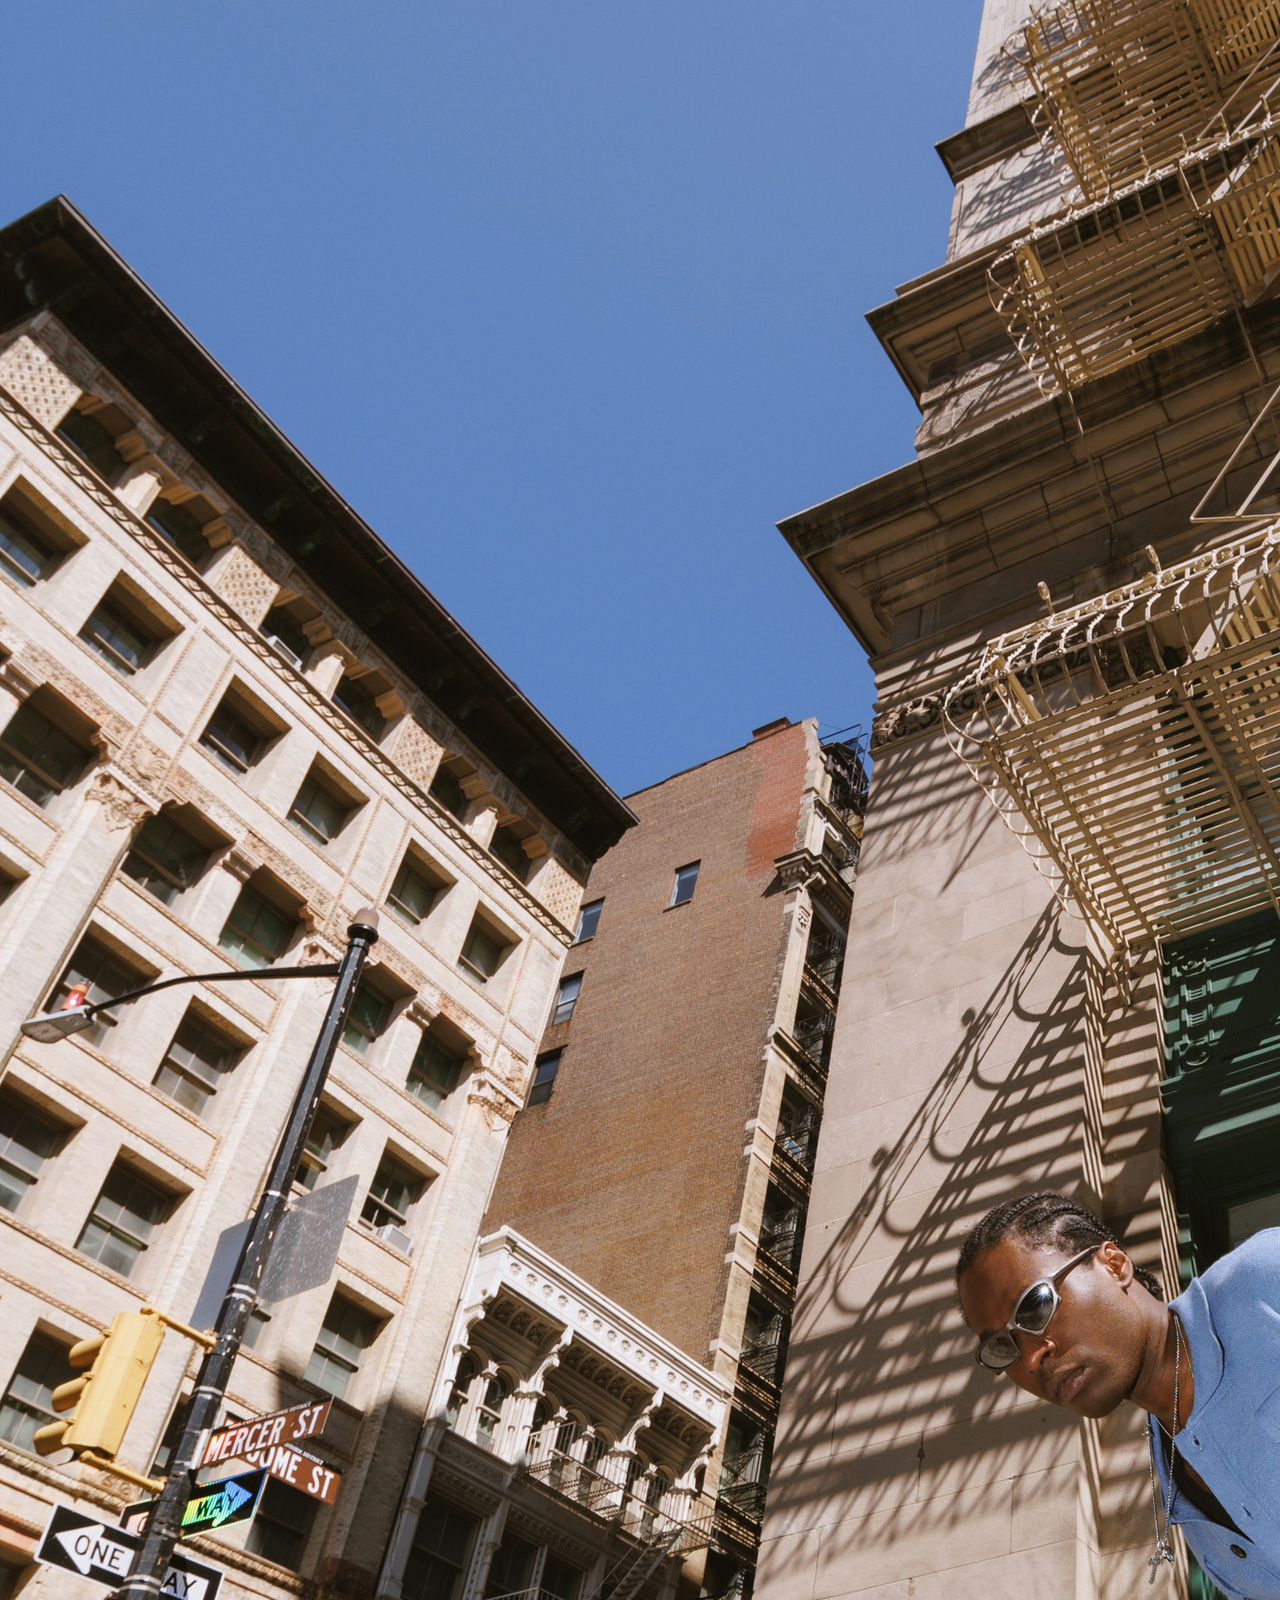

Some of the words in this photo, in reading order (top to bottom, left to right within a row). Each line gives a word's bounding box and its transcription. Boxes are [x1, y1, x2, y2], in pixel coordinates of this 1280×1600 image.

[203, 1416, 286, 1464] MERCER
[293, 1405, 324, 1438] ST
[307, 1465, 335, 1499] ST
[75, 1534, 125, 1570] ONE
[163, 1571, 197, 1598] AY
